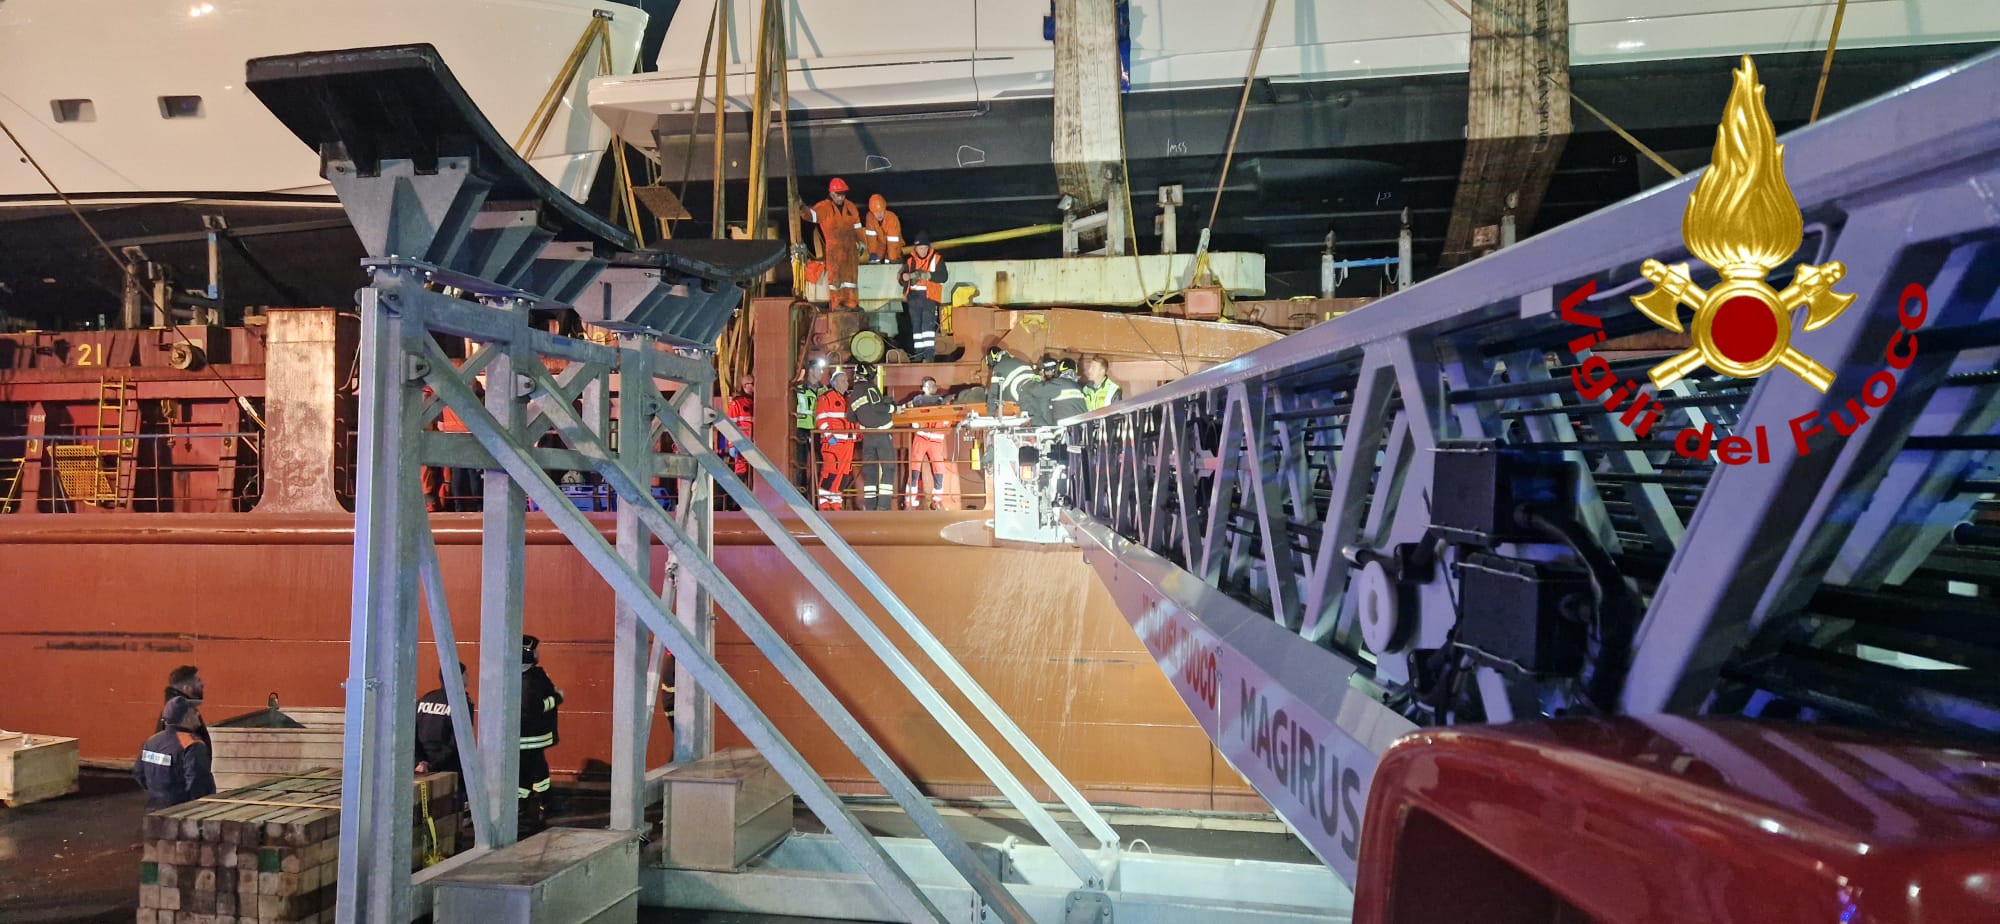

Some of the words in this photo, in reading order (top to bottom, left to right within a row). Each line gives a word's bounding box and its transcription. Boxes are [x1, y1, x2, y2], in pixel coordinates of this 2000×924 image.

[77, 343, 102, 366] 21
[1180, 626, 1217, 711] FUOCO
[417, 701, 452, 717] POLIZIA
[1240, 676, 1362, 863] MAGIRUS
